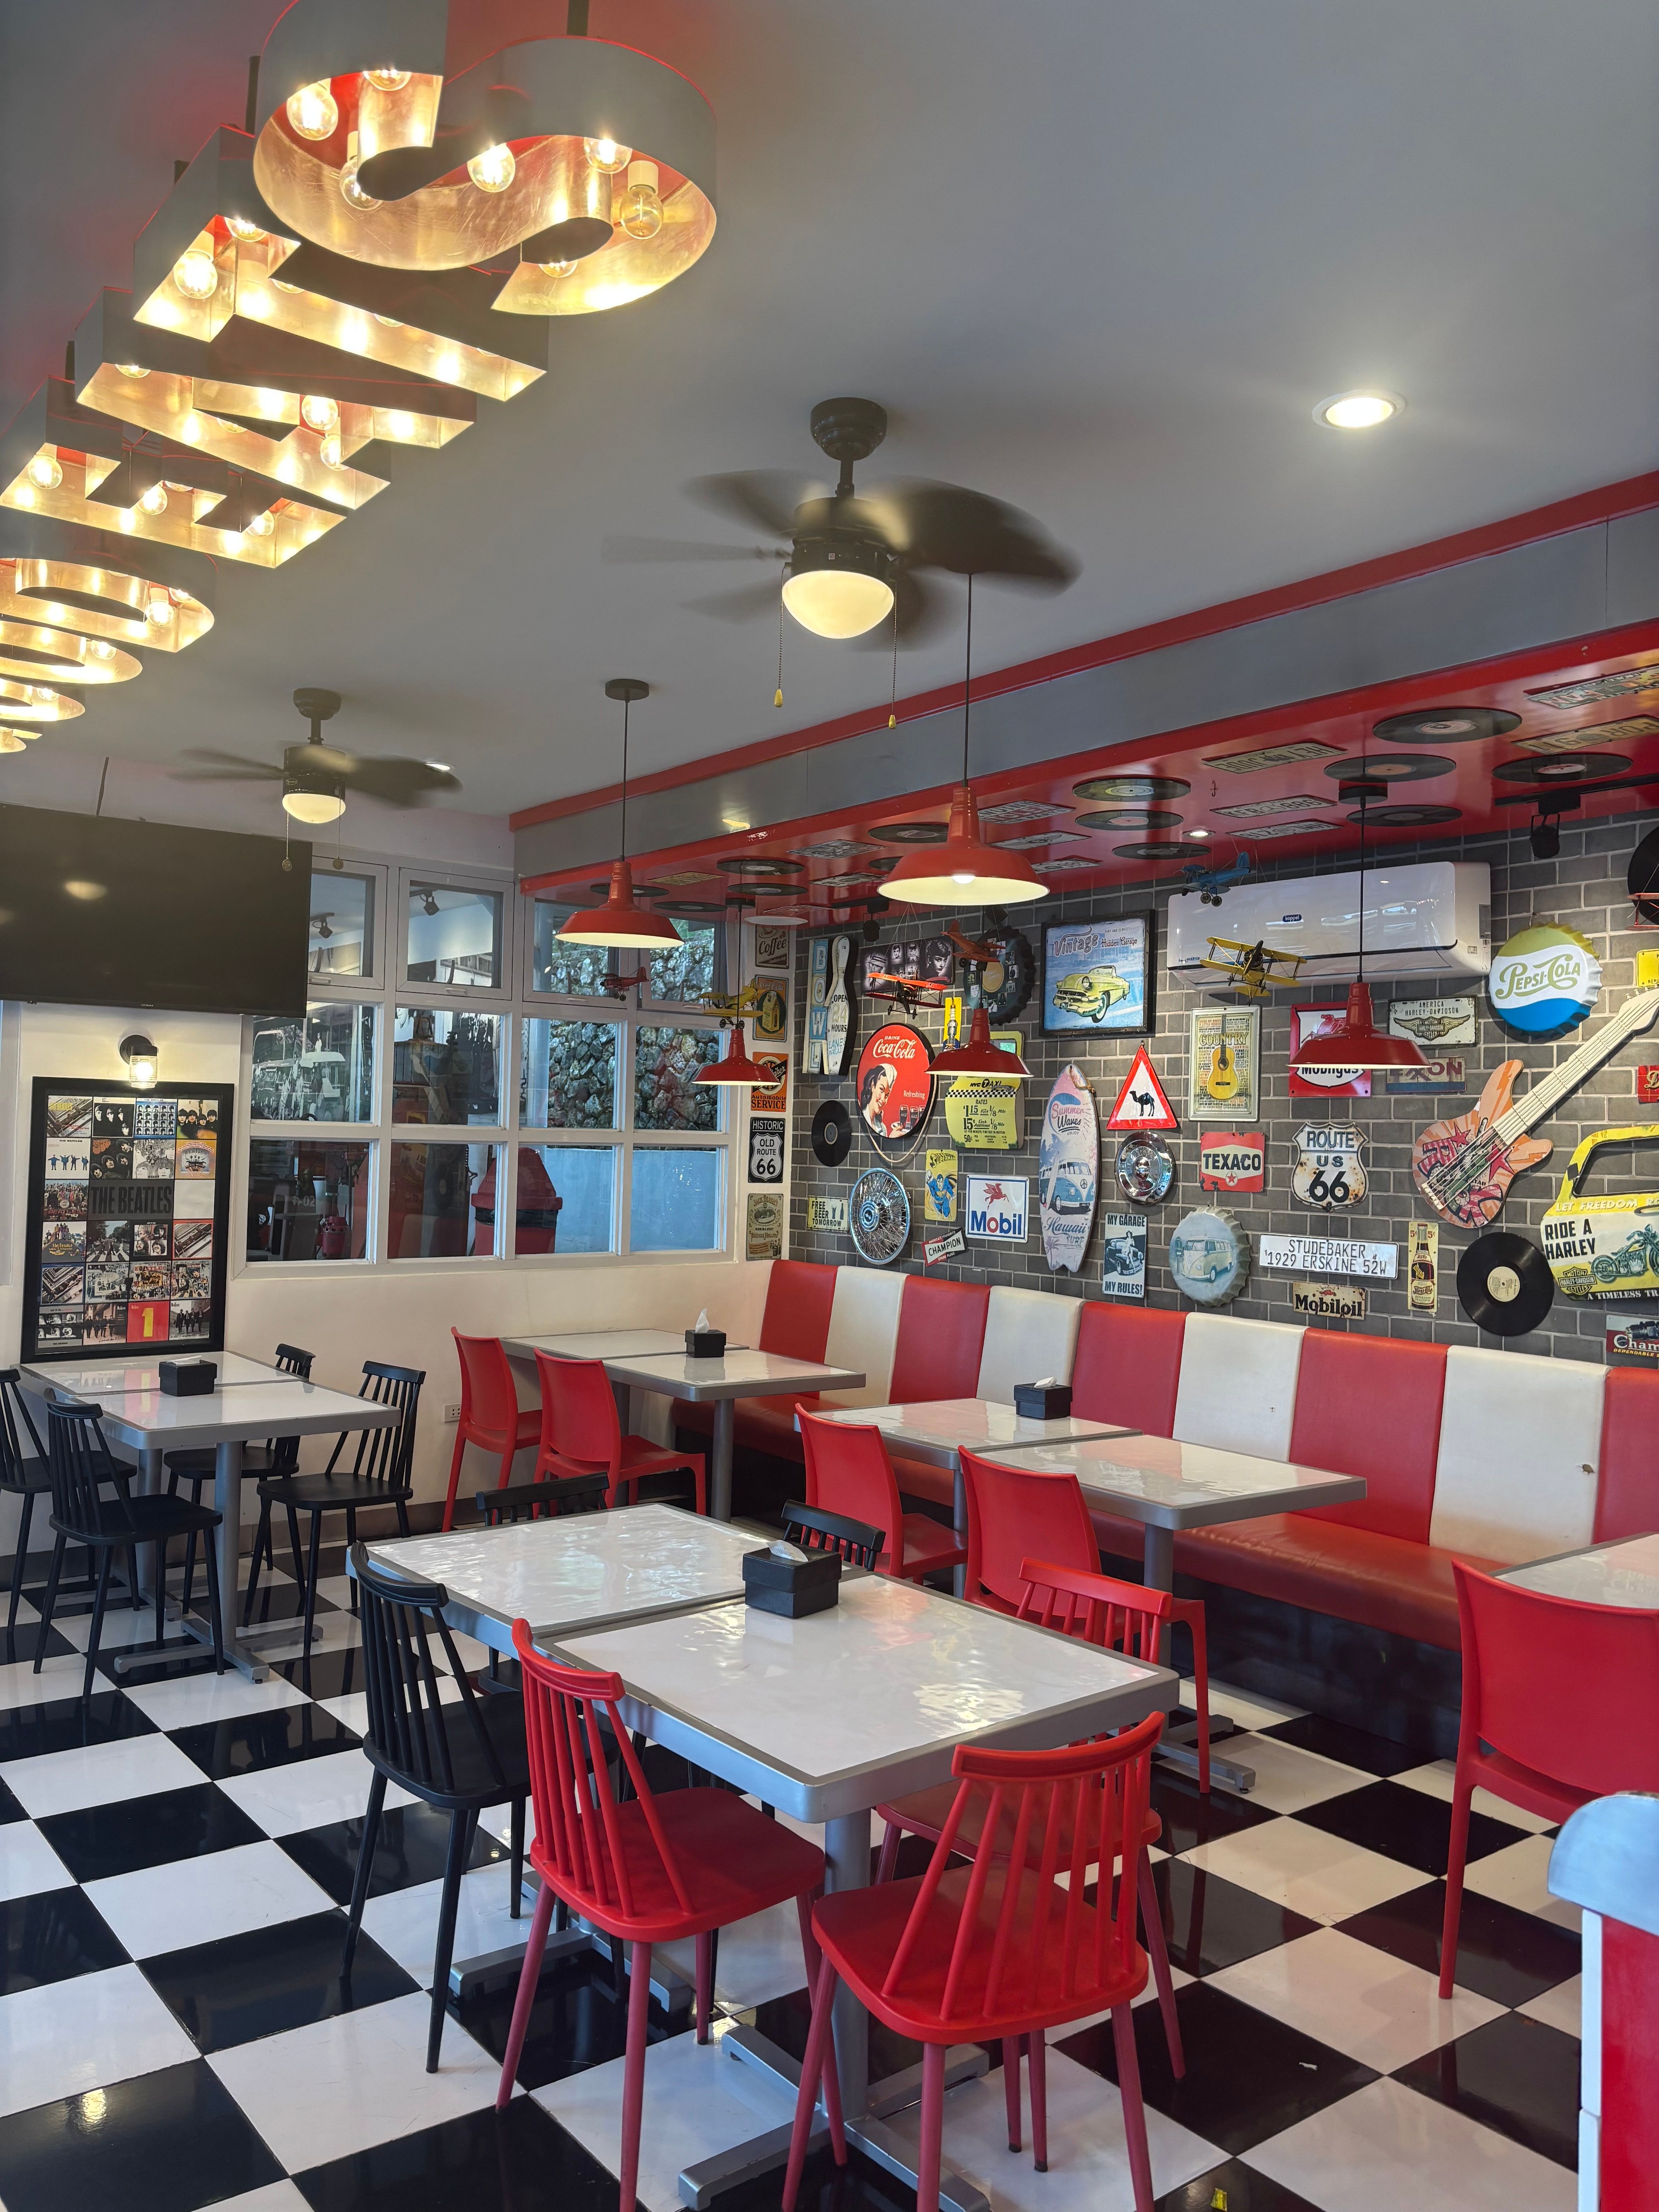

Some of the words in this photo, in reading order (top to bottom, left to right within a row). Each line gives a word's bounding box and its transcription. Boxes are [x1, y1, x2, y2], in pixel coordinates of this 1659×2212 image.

[1288, 745, 1334, 759] HEY
[1215, 757, 1267, 771] JUDE
[759, 938, 787, 956] Coffee
[1054, 927, 1099, 956] Vintage
[1101, 938, 1119, 948] Hidden
[1120, 936, 1137, 946] Garage
[833, 1003, 848, 1023] 24
[831, 1024, 847, 1032] HOURS
[1199, 1032, 1249, 1046] COUNTRY
[872, 1039, 917, 1059] Coca-Cola
[982, 1079, 1002, 1088] TAXI
[903, 1090, 925, 1100] Refreshing
[751, 1099, 786, 1109] SERVICE
[1051, 1103, 1084, 1119] Summer
[752, 1120, 783, 1130] HISTORIC
[1058, 1114, 1082, 1128] Waves
[759, 1138, 775, 1147] OLD
[1307, 1130, 1354, 1148] ROUTE
[756, 1158, 776, 1175] 66
[930, 1152, 956, 1168] SUPERMAN
[1203, 1153, 1261, 1171] TEXACO
[1316, 1155, 1344, 1167] US
[1309, 1170, 1350, 1202] 66
[91, 1187, 115, 1214] THE
[118, 1186, 172, 1214] BEATLES
[812, 1200, 826, 1210] FREE
[1556, 1202, 1575, 1212] LET
[1580, 1198, 1638, 1211] FREEDOM
[814, 1209, 829, 1219] BEER
[1107, 1214, 1118, 1225] MY
[1119, 1214, 1145, 1227] GARAGE
[812, 1218, 842, 1227] TOMORROW
[971, 1210, 1022, 1235] Mobil
[1045, 1216, 1086, 1236] Hawaii
[1544, 1221, 1576, 1241] RIDE
[1583, 1218, 1592, 1235] A
[928, 1237, 961, 1256] CHAMPION
[1288, 1239, 1365, 1259] STUDEBAKER
[1544, 1237, 1595, 1260] HARLEY
[1267, 1251, 1297, 1267] 1929
[1302, 1255, 1357, 1273] ERSKINE
[1363, 1259, 1387, 1275] 52W
[1105, 1281, 1116, 1292] MY
[1117, 1282, 1143, 1295] RULES!
[1595, 1290, 1642, 1300] TIMELESS
[1295, 1294, 1362, 1317] Mobiloil
[142, 1307, 154, 1337] 1
[1613, 1348, 1654, 1357] DEPENDABLE
